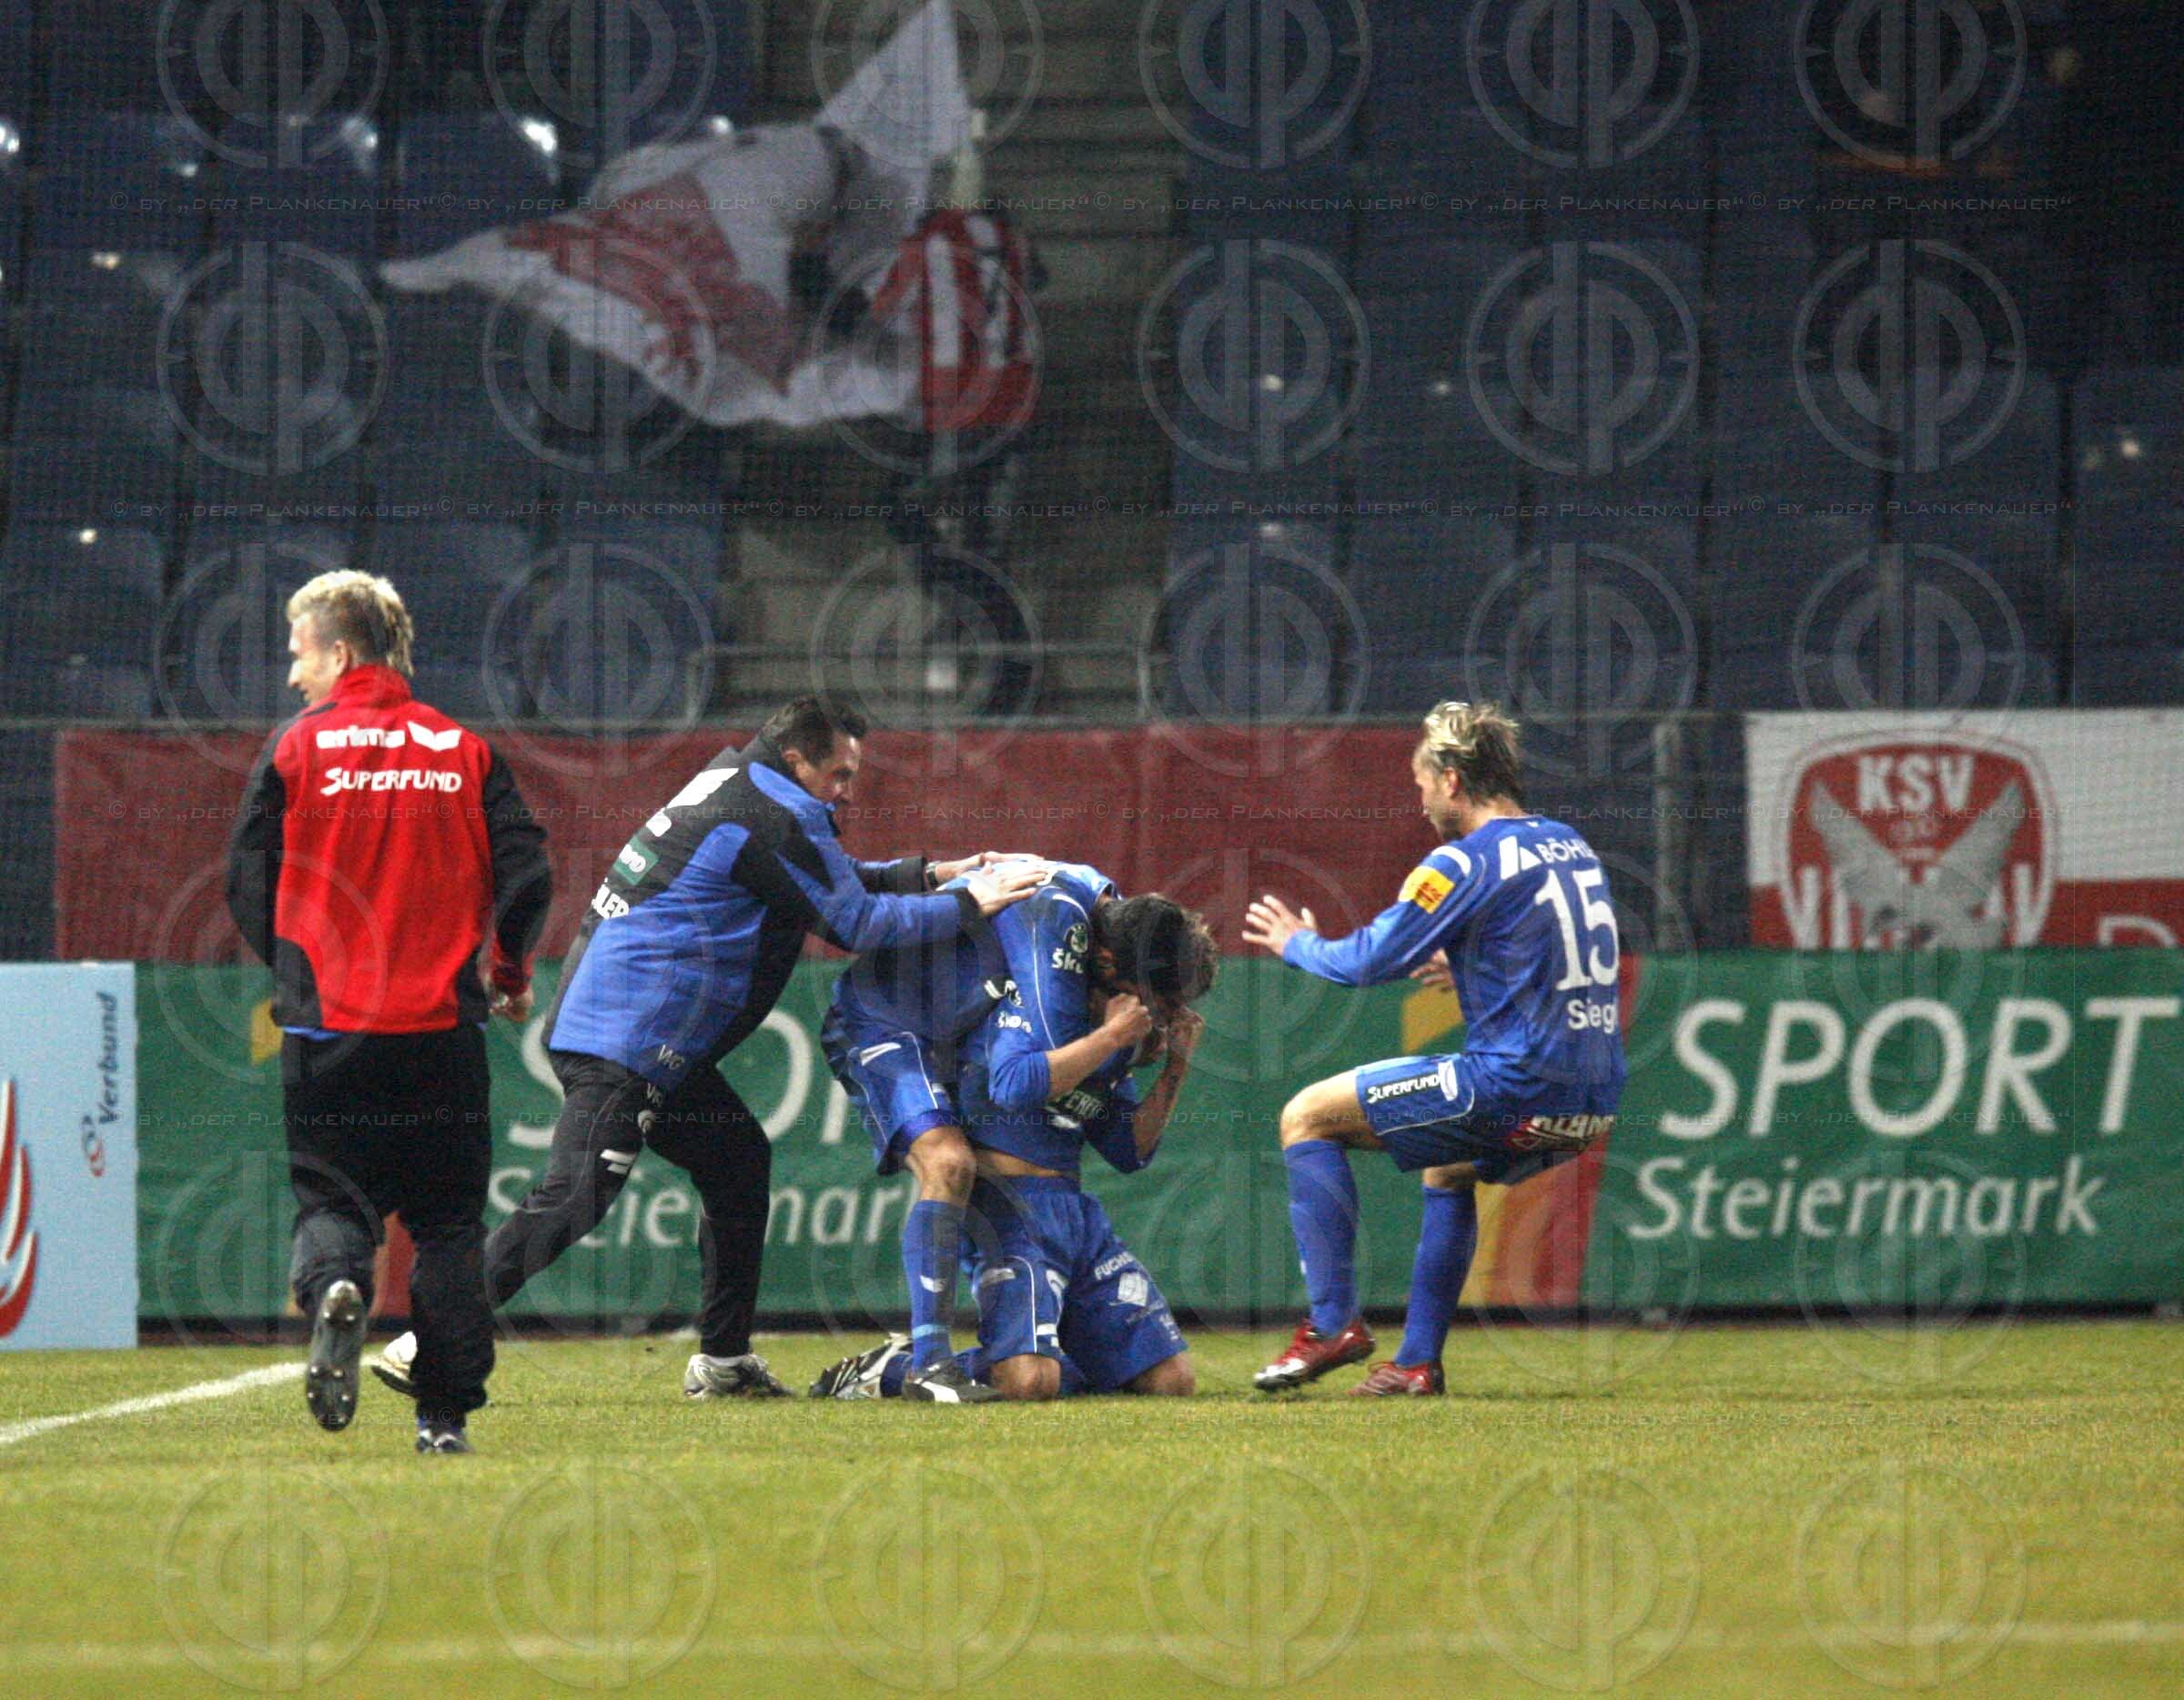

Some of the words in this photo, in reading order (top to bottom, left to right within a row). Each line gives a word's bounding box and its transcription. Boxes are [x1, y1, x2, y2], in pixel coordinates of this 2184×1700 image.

[320, 767, 462, 796] SUPERFUND
[1857, 754, 1976, 812] KSV
[1535, 867, 1620, 990] 15
[96, 991, 118, 1124] Verbund
[1368, 1074, 1441, 1104] SUPERFUND
[1656, 996, 2181, 1139] SPORT
[1626, 1152, 2105, 1240] Steiermark
